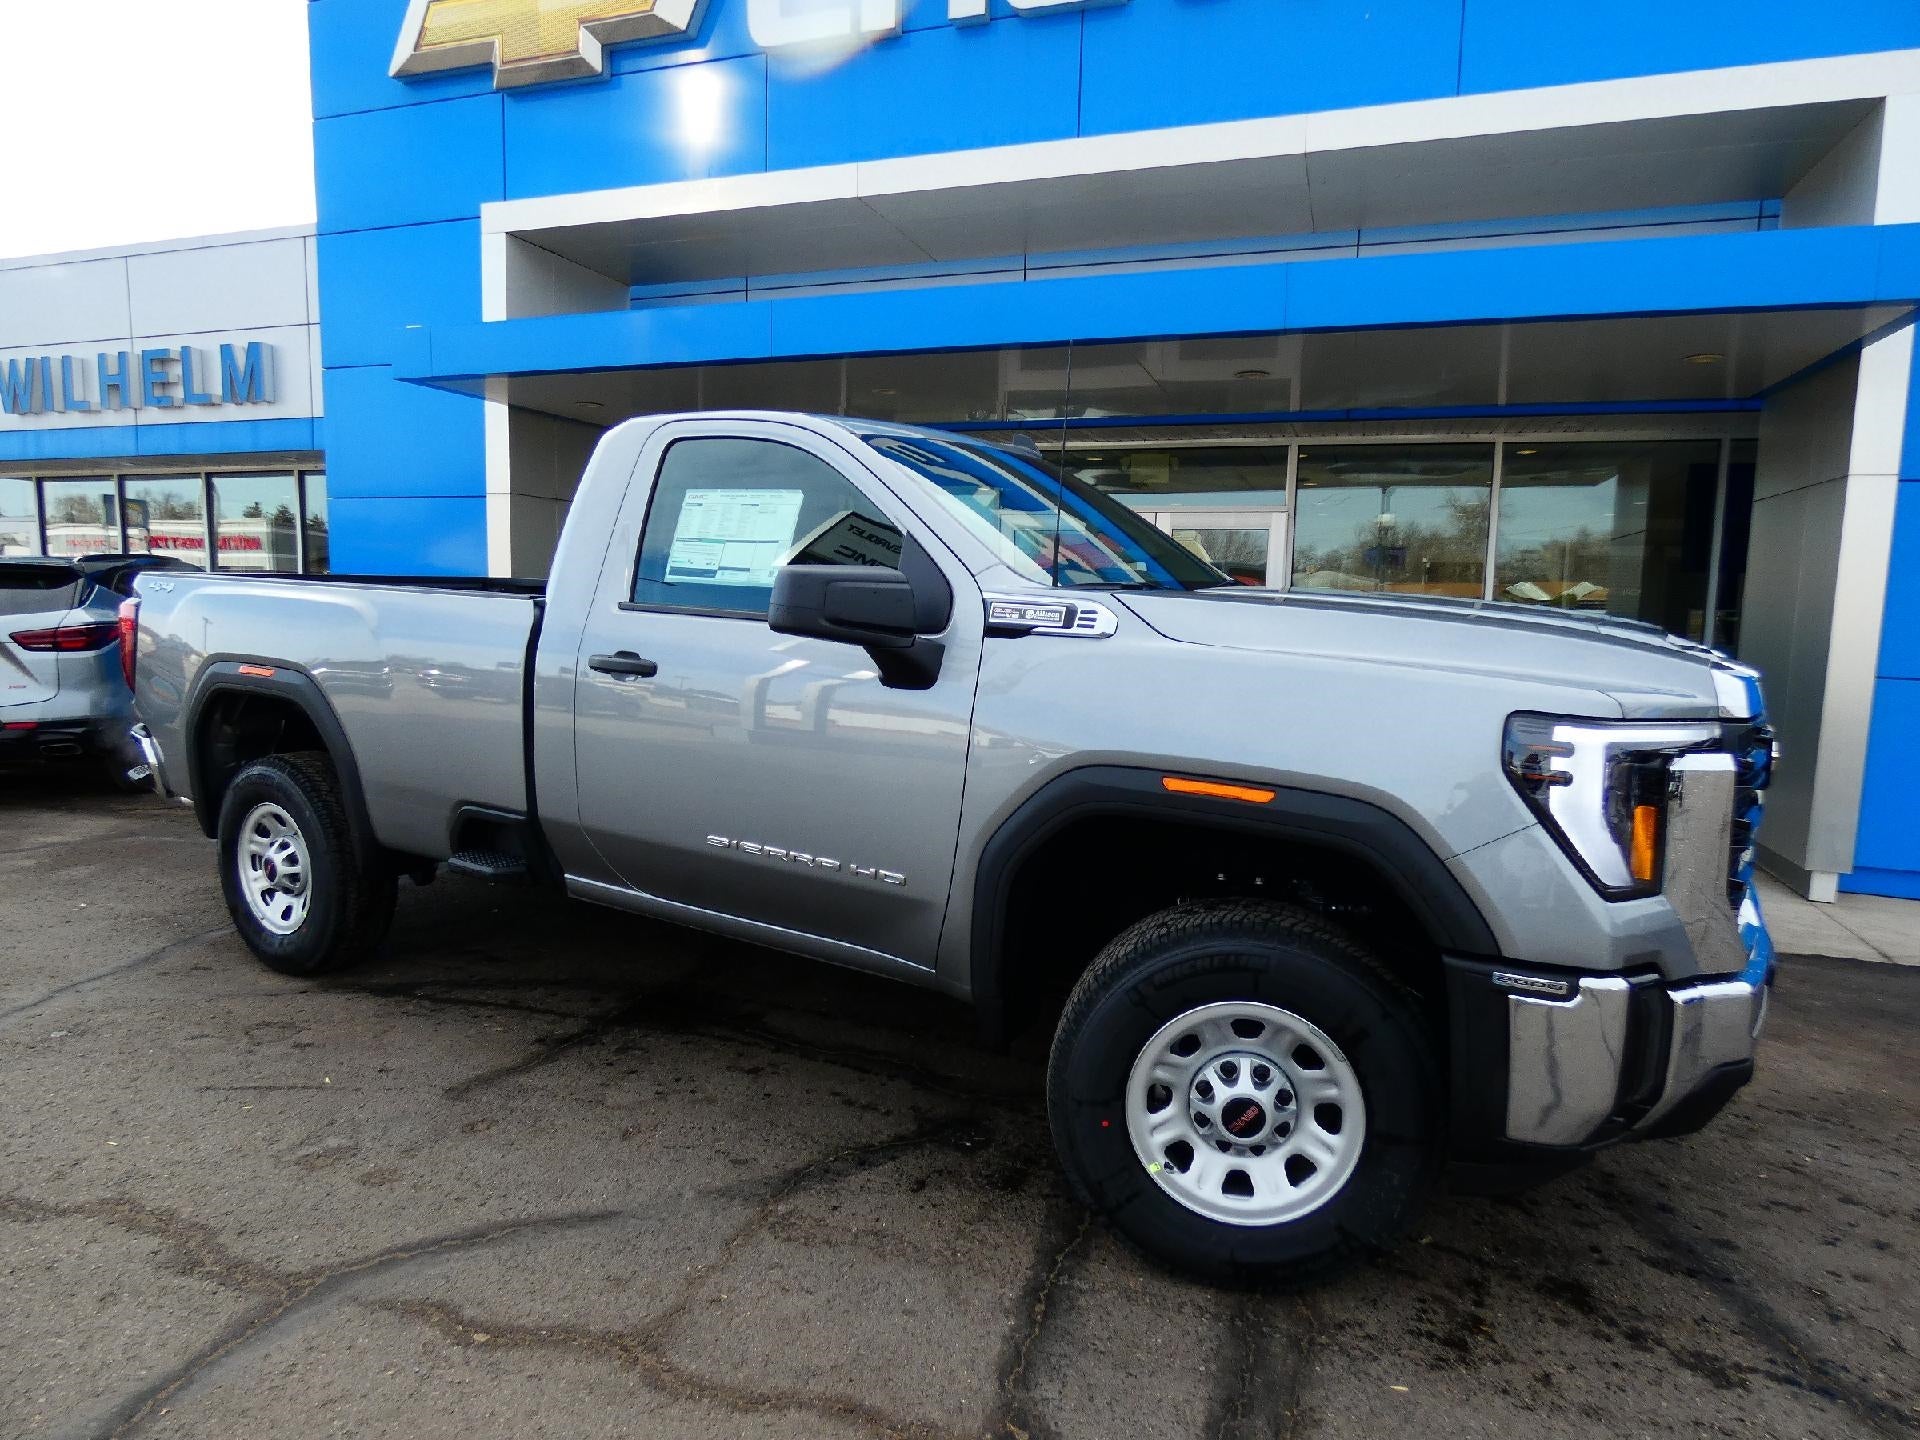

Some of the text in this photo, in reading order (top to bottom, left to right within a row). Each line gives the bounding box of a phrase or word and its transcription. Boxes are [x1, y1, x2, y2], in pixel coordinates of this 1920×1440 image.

[0, 342, 274, 415] WILHELM
[706, 834, 907, 887] SIERRA HD
